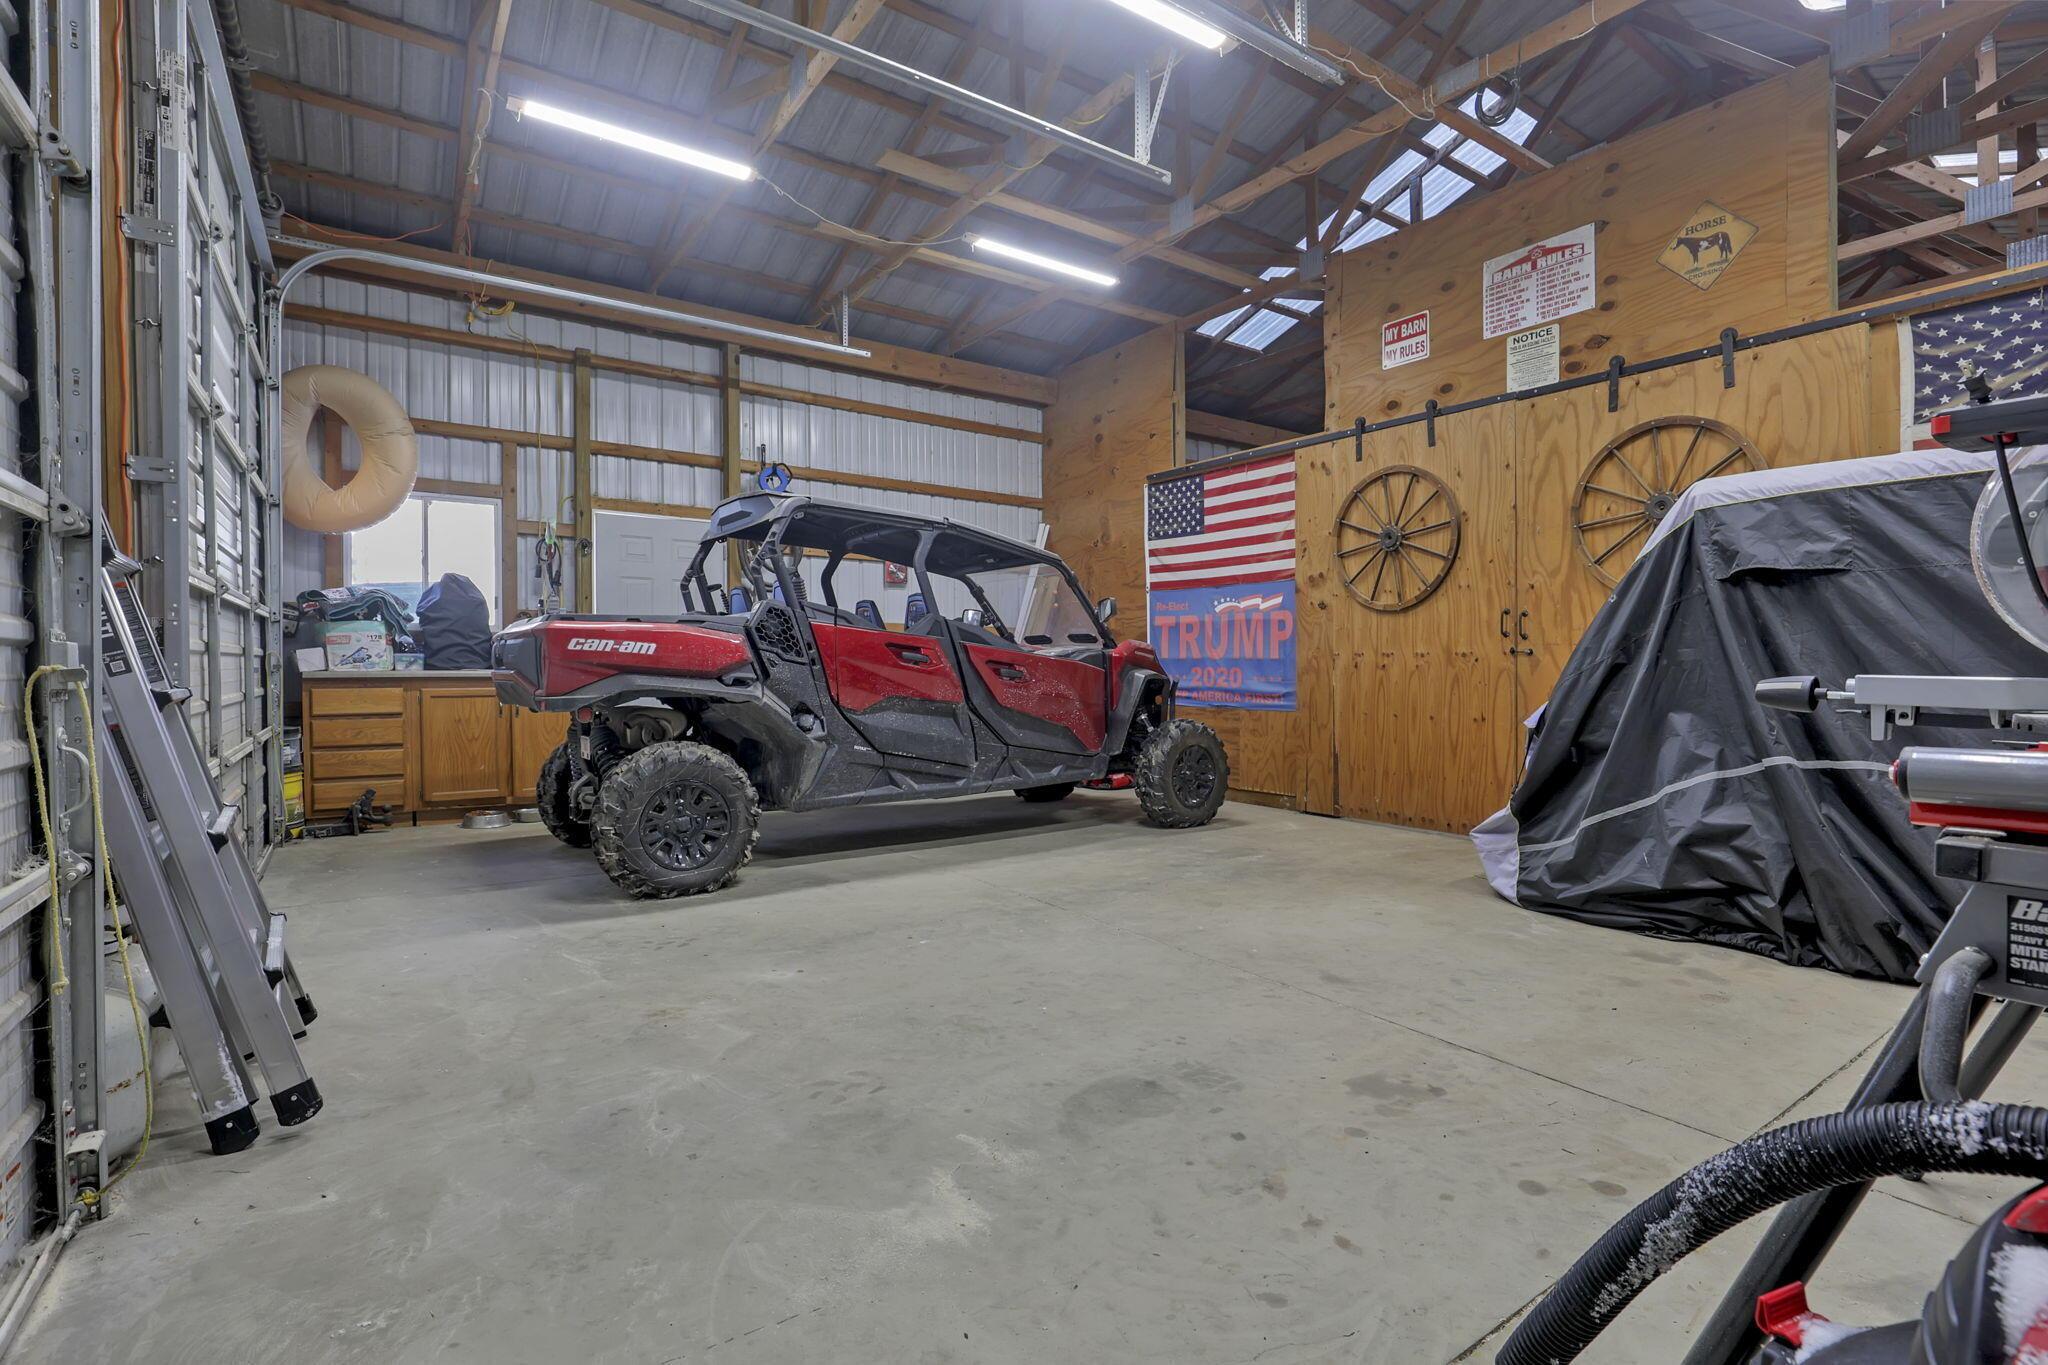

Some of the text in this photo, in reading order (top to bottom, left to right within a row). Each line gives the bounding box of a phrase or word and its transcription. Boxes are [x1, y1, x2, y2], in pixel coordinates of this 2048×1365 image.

[1685, 216, 1727, 236] HORSE
[1494, 245, 1583, 283] BARN RULES
[1688, 266, 1723, 281] CROSSING
[1386, 318, 1426, 342] MY BARN
[1513, 327, 1553, 345] NOTICE
[1386, 340, 1425, 362] MY RULES
[1154, 609, 1294, 660] TRUMP
[568, 638, 656, 654] can-am
[1191, 666, 1242, 688] 2020
[2010, 934, 2044, 945] HEAVY
[2010, 944, 2048, 960] MITE
[2010, 957, 2048, 974] STAN
